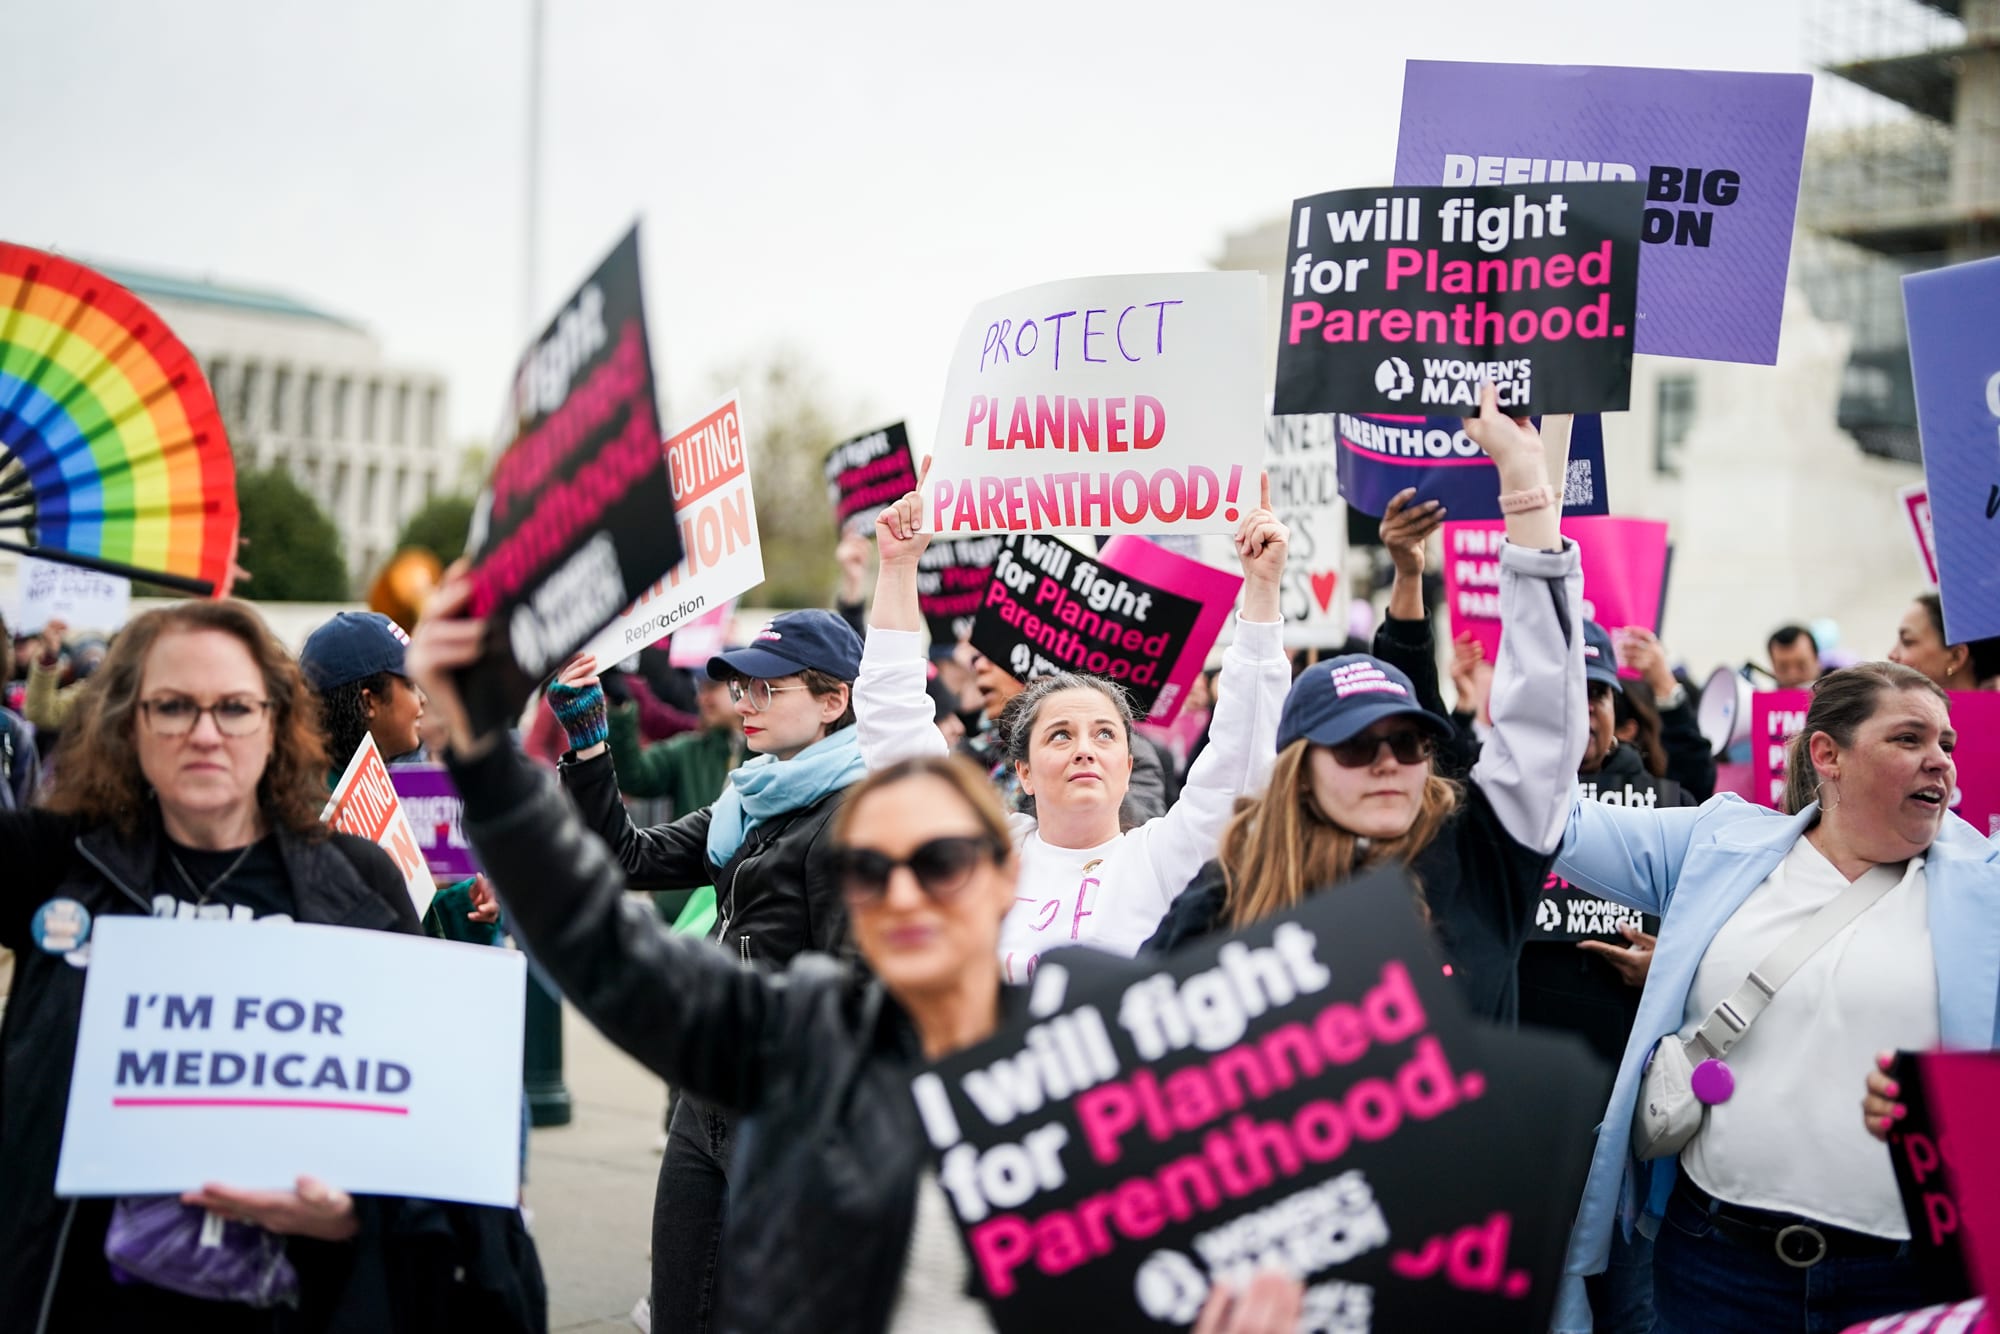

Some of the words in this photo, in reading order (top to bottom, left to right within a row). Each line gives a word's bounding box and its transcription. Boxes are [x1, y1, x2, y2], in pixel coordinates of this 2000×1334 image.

[1646, 165, 1741, 207] BIG
[1297, 206, 1312, 248] I
[1325, 198, 1421, 243] will
[1437, 193, 1569, 253] fight
[1641, 208, 1714, 248] ON
[1291, 252, 1369, 296] for
[1385, 240, 1614, 294] Planned
[979, 299, 1184, 373] PROTECT
[1288, 293, 1627, 346] Parenthood.
[1422, 357, 1532, 382] WOMEN'S
[964, 393, 1168, 453] PLANNED
[1339, 413, 1488, 457] PARENTHOO
[667, 411, 741, 502] CUTING
[933, 463, 1244, 533] PARENTHOOD!
[995, 549, 1036, 595] for
[1035, 575, 1171, 659] Planned
[1021, 535, 1073, 581] will
[1070, 561, 1153, 623] fight
[625, 594, 705, 645] Reproaction
[985, 580, 1162, 689] Parenthood.
[1566, 914, 1643, 935] MARCH
[122, 994, 214, 1030] I'M
[233, 996, 345, 1037] FOR
[911, 1072, 962, 1150] I
[961, 1003, 1121, 1125] will
[1118, 920, 1331, 1062] fight
[114, 1050, 413, 1095] MEDICAID
[940, 1121, 1070, 1223] for
[1075, 959, 1429, 1165] Planned
[968, 1034, 1487, 1298] Parenthood.
